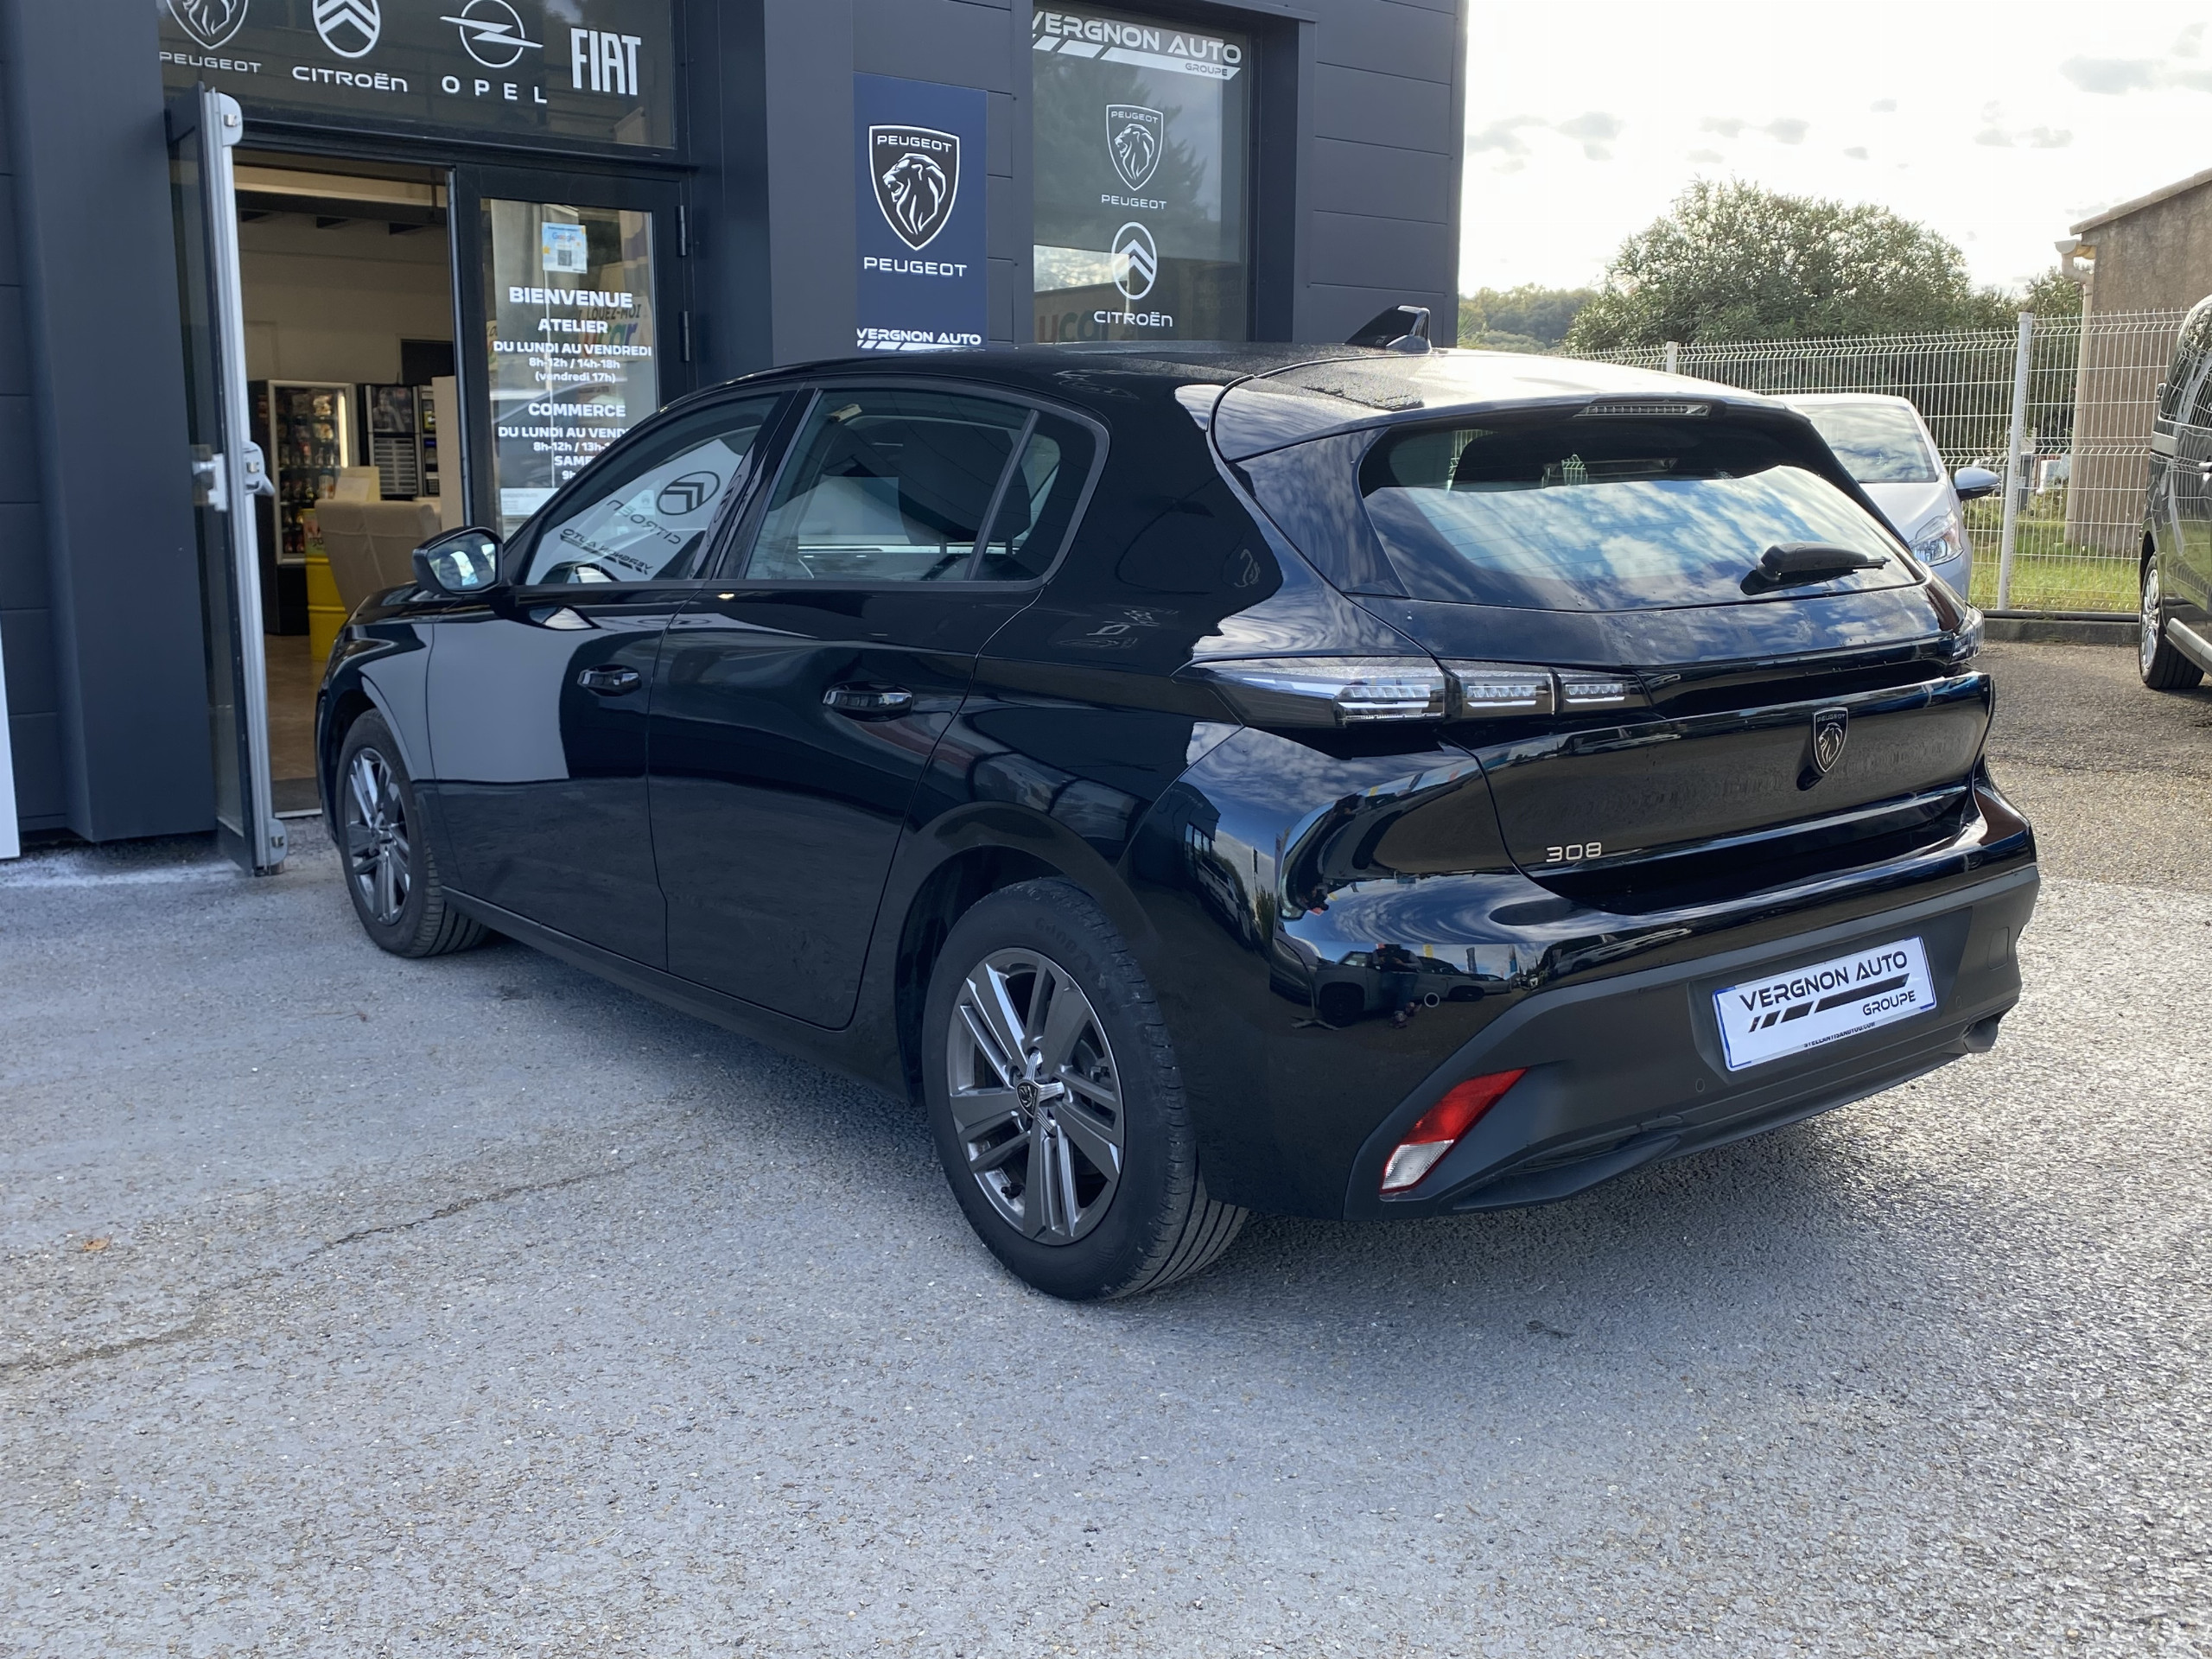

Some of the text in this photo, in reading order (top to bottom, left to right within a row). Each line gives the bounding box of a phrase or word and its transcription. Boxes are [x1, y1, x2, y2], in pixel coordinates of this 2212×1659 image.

[1166, 35, 1242, 64] AUTO
[159, 51, 262, 73] PEUGEOT
[570, 27, 642, 96] FIAT
[1185, 62, 1228, 76] GROUPE
[442, 74, 548, 104] OPEL
[1110, 111, 1159, 124] PEUGEOT
[877, 135, 952, 153] PEUGEOT
[1101, 194, 1167, 210] PEUGEOT
[864, 257, 968, 277] PEUGEOT
[509, 286, 633, 308] BIENVENUE
[537, 318, 608, 334] ATELIER
[856, 327, 982, 346] VERGNON AUTO
[493, 340, 652, 356] DU LUNDI AU VENDREDI
[529, 357, 568, 368] 8h-12h
[578, 359, 621, 369] 14h-18h
[535, 371, 616, 384] (vendredi 17h)
[528, 403, 626, 417] COMMERCE
[499, 426, 630, 438] DU LUNDI AU VEND
[533, 442, 572, 451] 8h-12h
[554, 455, 595, 467] SAME
[1817, 713, 1846, 723] PEUGEOT
[1546, 842, 1602, 863] 308
[1739, 950, 1908, 1011] VERGNON AUTO
[1862, 989, 1916, 1016] GROUPE
